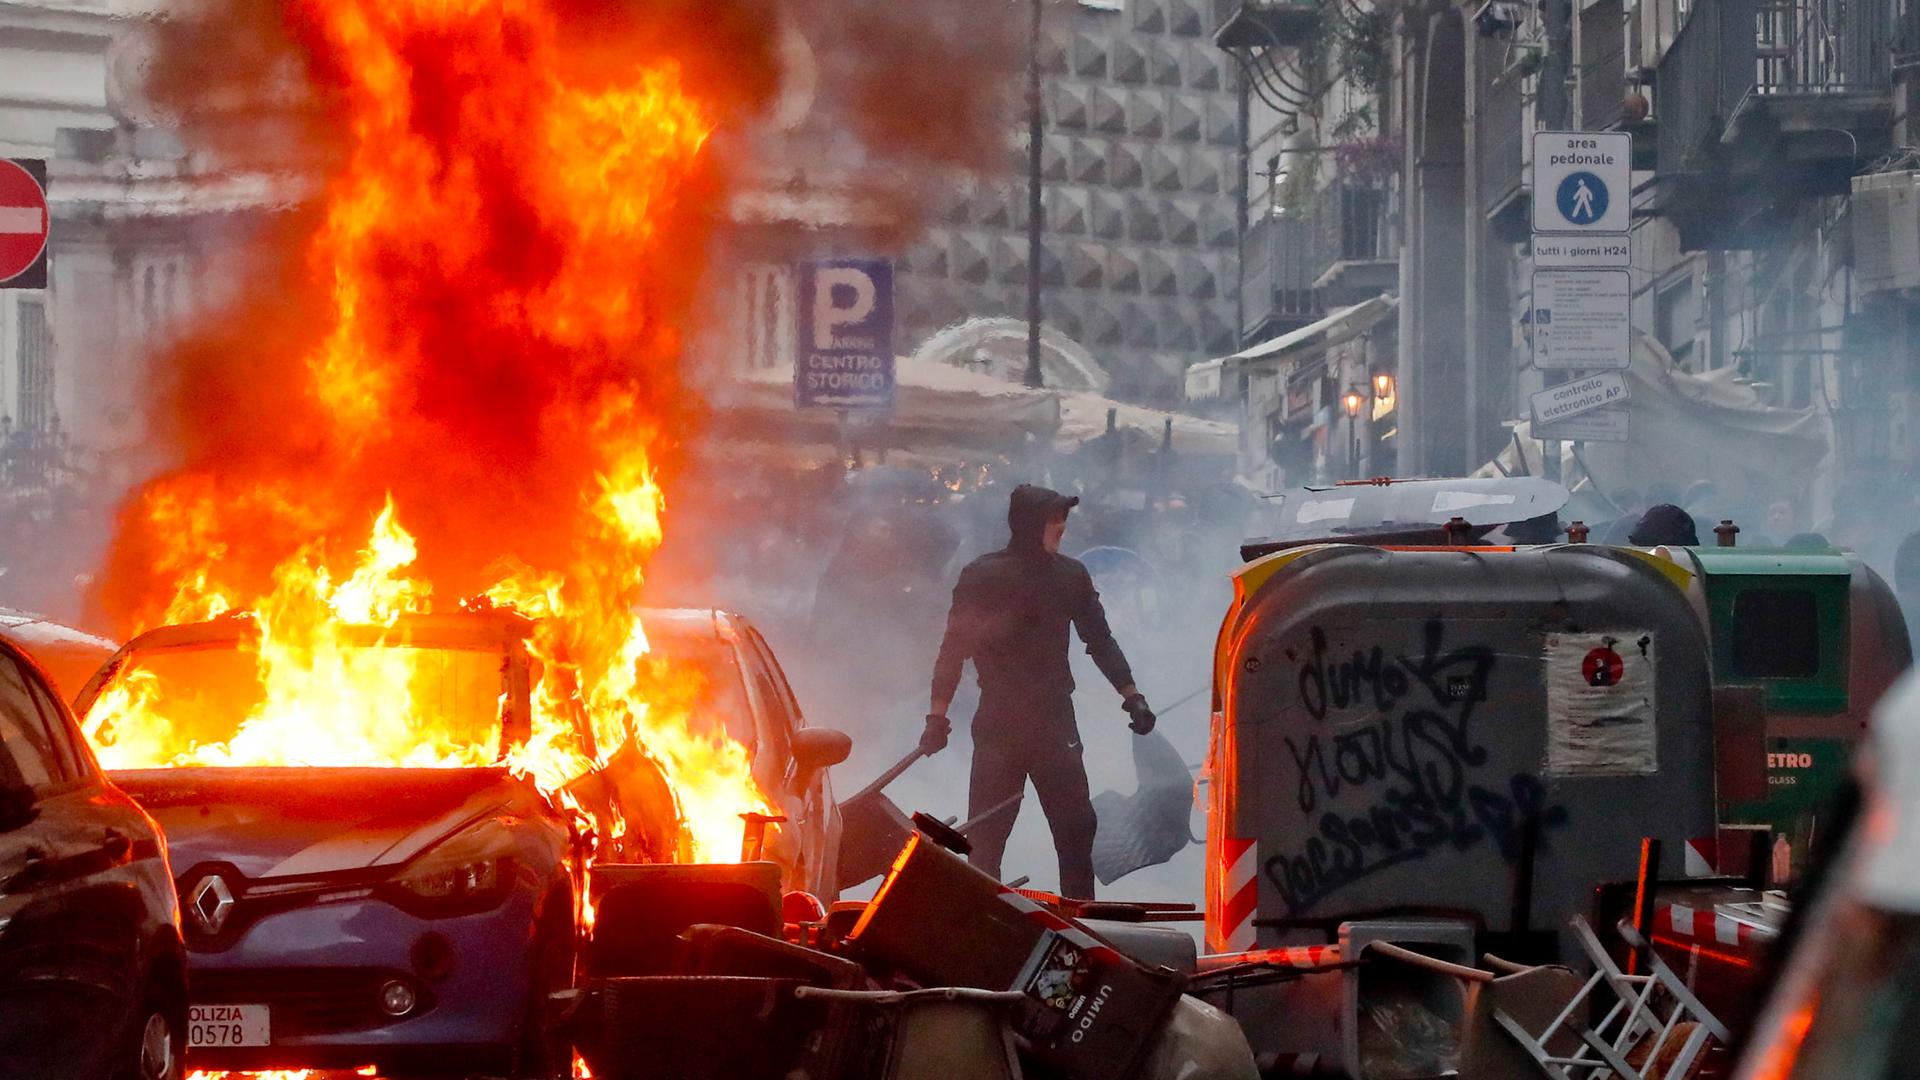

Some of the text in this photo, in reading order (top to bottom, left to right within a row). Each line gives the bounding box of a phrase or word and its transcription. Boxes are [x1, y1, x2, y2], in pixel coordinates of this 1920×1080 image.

[1567, 140, 1597, 149] area
[1550, 153, 1614, 166] pedonale
[1537, 246, 1560, 256] tutti
[1570, 246, 1600, 257] giorni
[1604, 246, 1627, 256] H24
[813, 267, 877, 350] P
[808, 354, 882, 369] CENTRO
[806, 372, 884, 389] STORICO
[1553, 379, 1603, 401] controllo
[1543, 386, 1620, 418] elettronico AP
[1767, 753, 1812, 768] ETRO
[1768, 776, 1796, 785] GLASS
[189, 1007, 243, 1021] OLIZIA
[1071, 984, 1113, 1043] UMIDO
[191, 1024, 243, 1045] 0578
